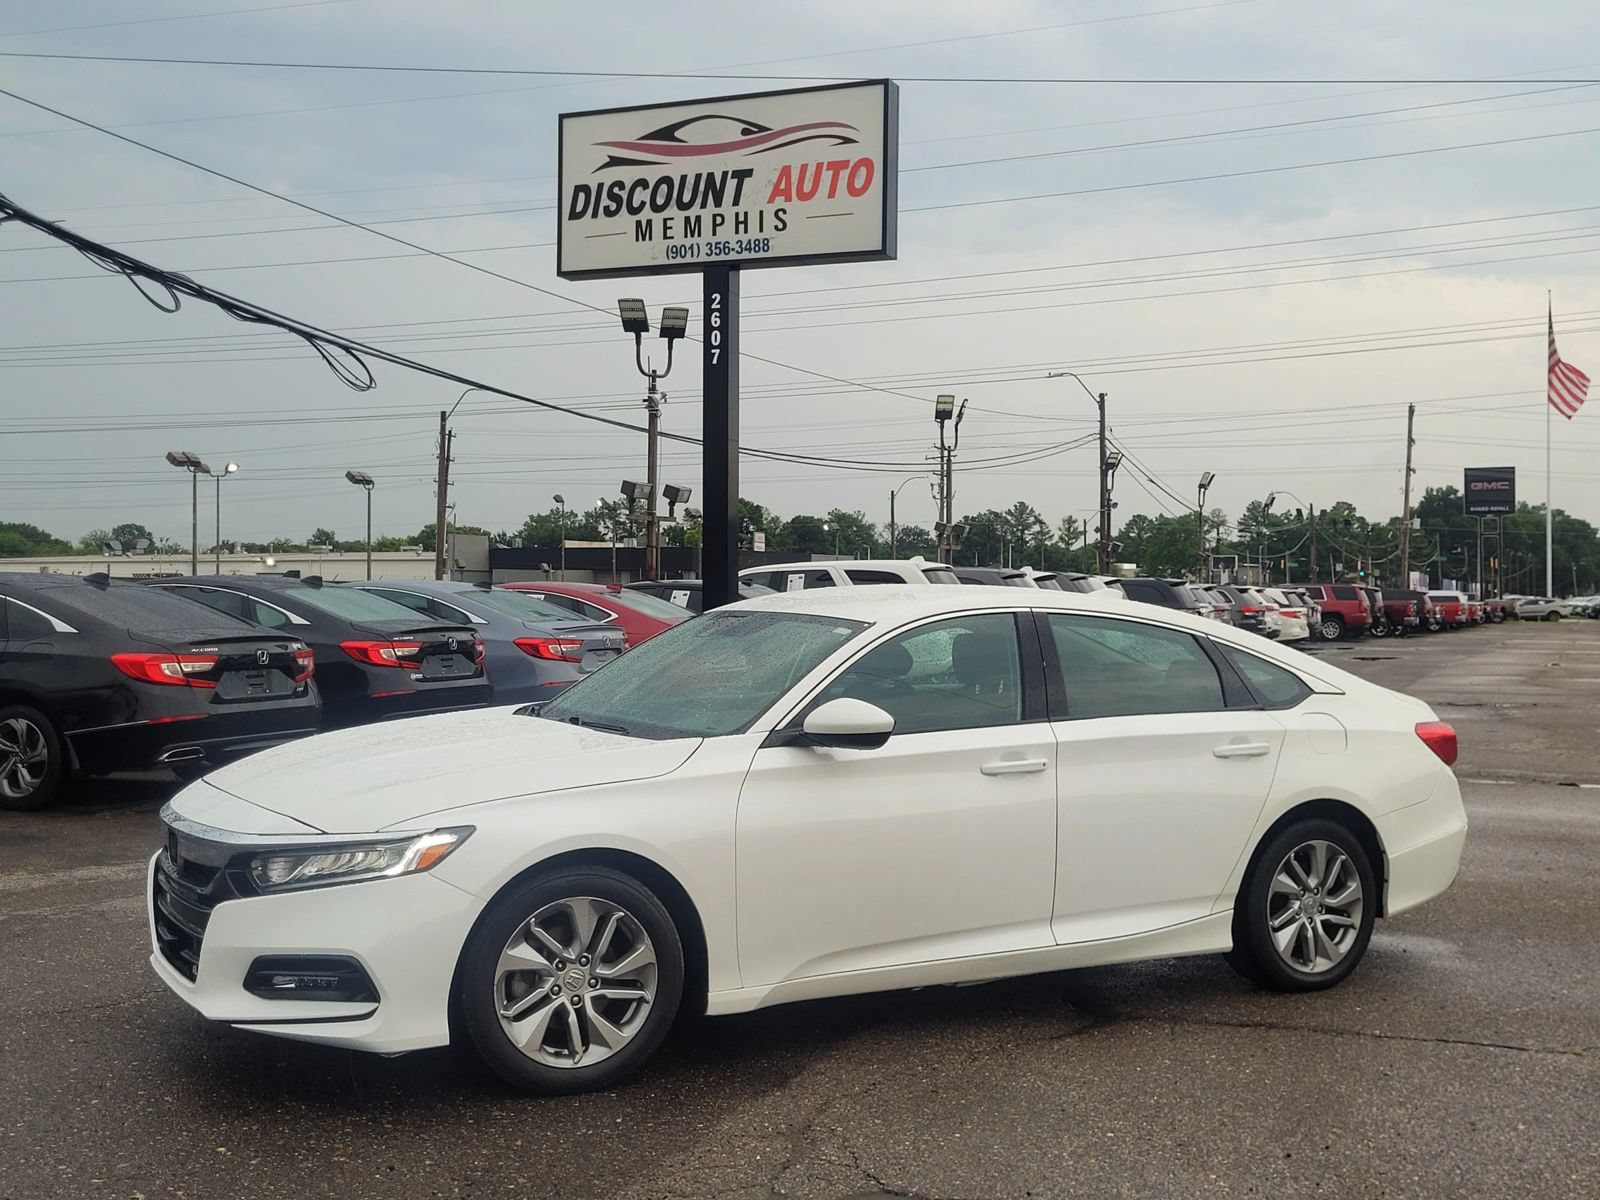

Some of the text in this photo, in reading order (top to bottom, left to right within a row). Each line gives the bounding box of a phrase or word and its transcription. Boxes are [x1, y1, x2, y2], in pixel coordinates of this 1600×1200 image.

[568, 157, 875, 221] DISCOUNT AUTO
[635, 208, 788, 242] MEMPHIS
[666, 238, 770, 260] (901) 356-3488
[710, 293, 721, 364] 2607
[1471, 481, 1509, 490] GMC
